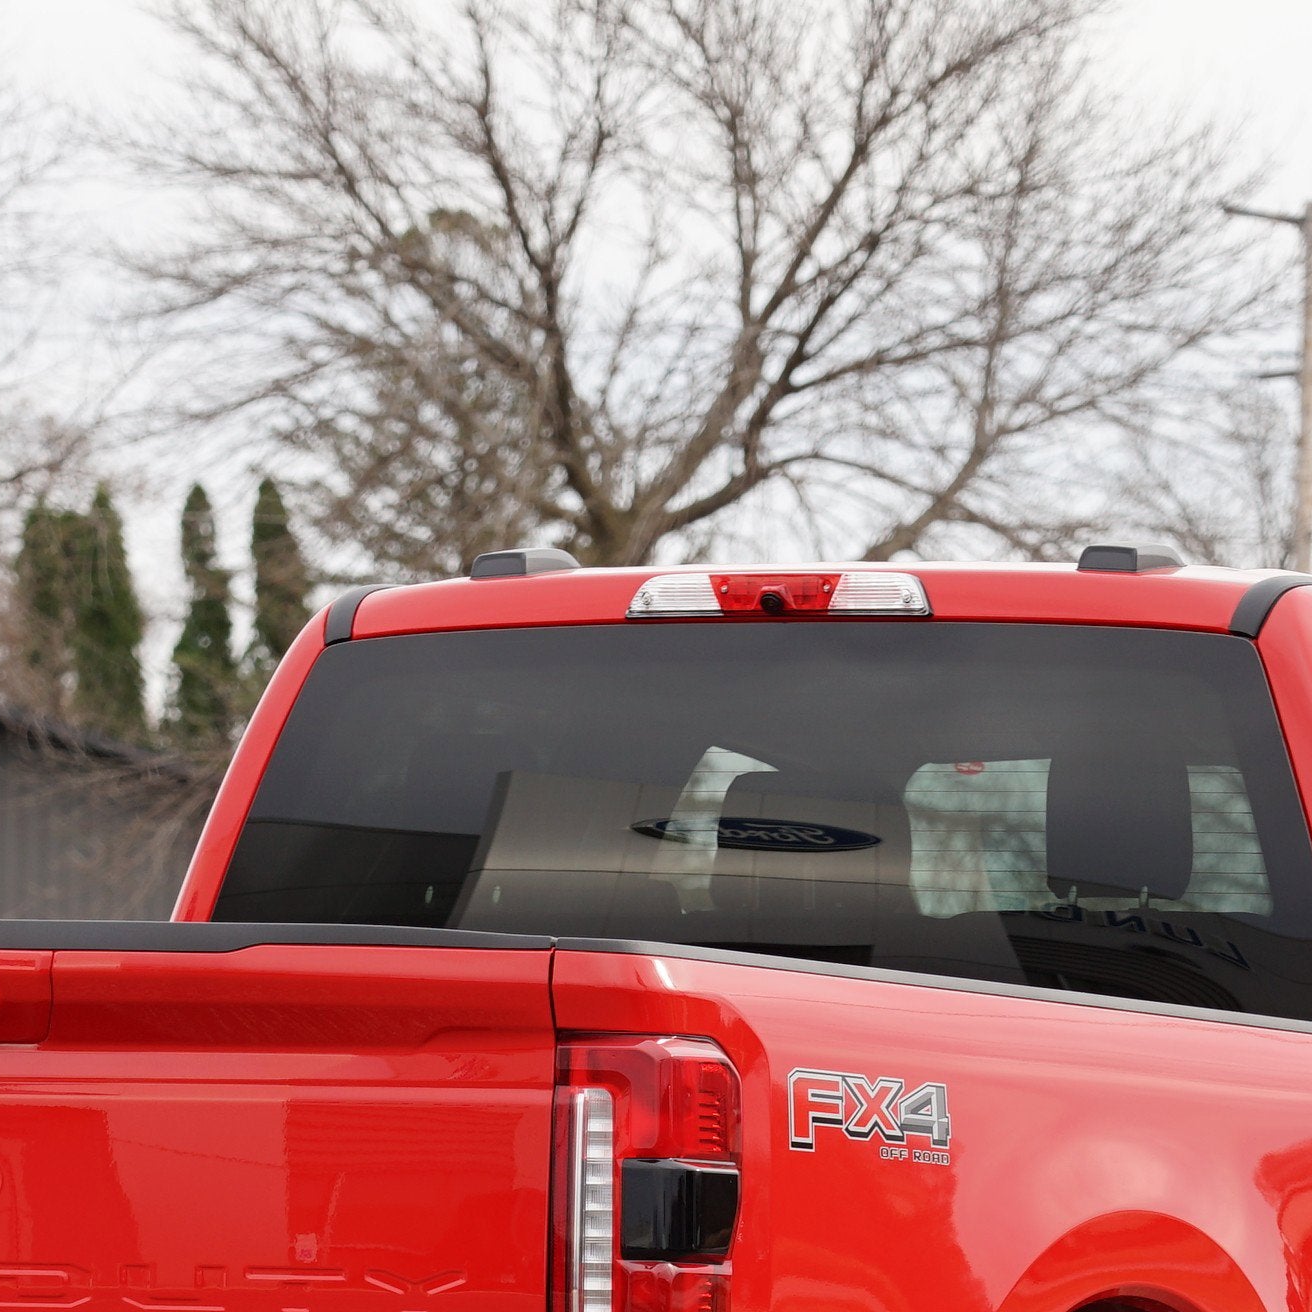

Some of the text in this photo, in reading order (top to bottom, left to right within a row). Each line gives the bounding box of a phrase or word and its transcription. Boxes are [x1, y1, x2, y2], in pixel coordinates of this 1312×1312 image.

[788, 1067, 951, 1152] FX4
[880, 1147, 950, 1166] OFF ROAD
